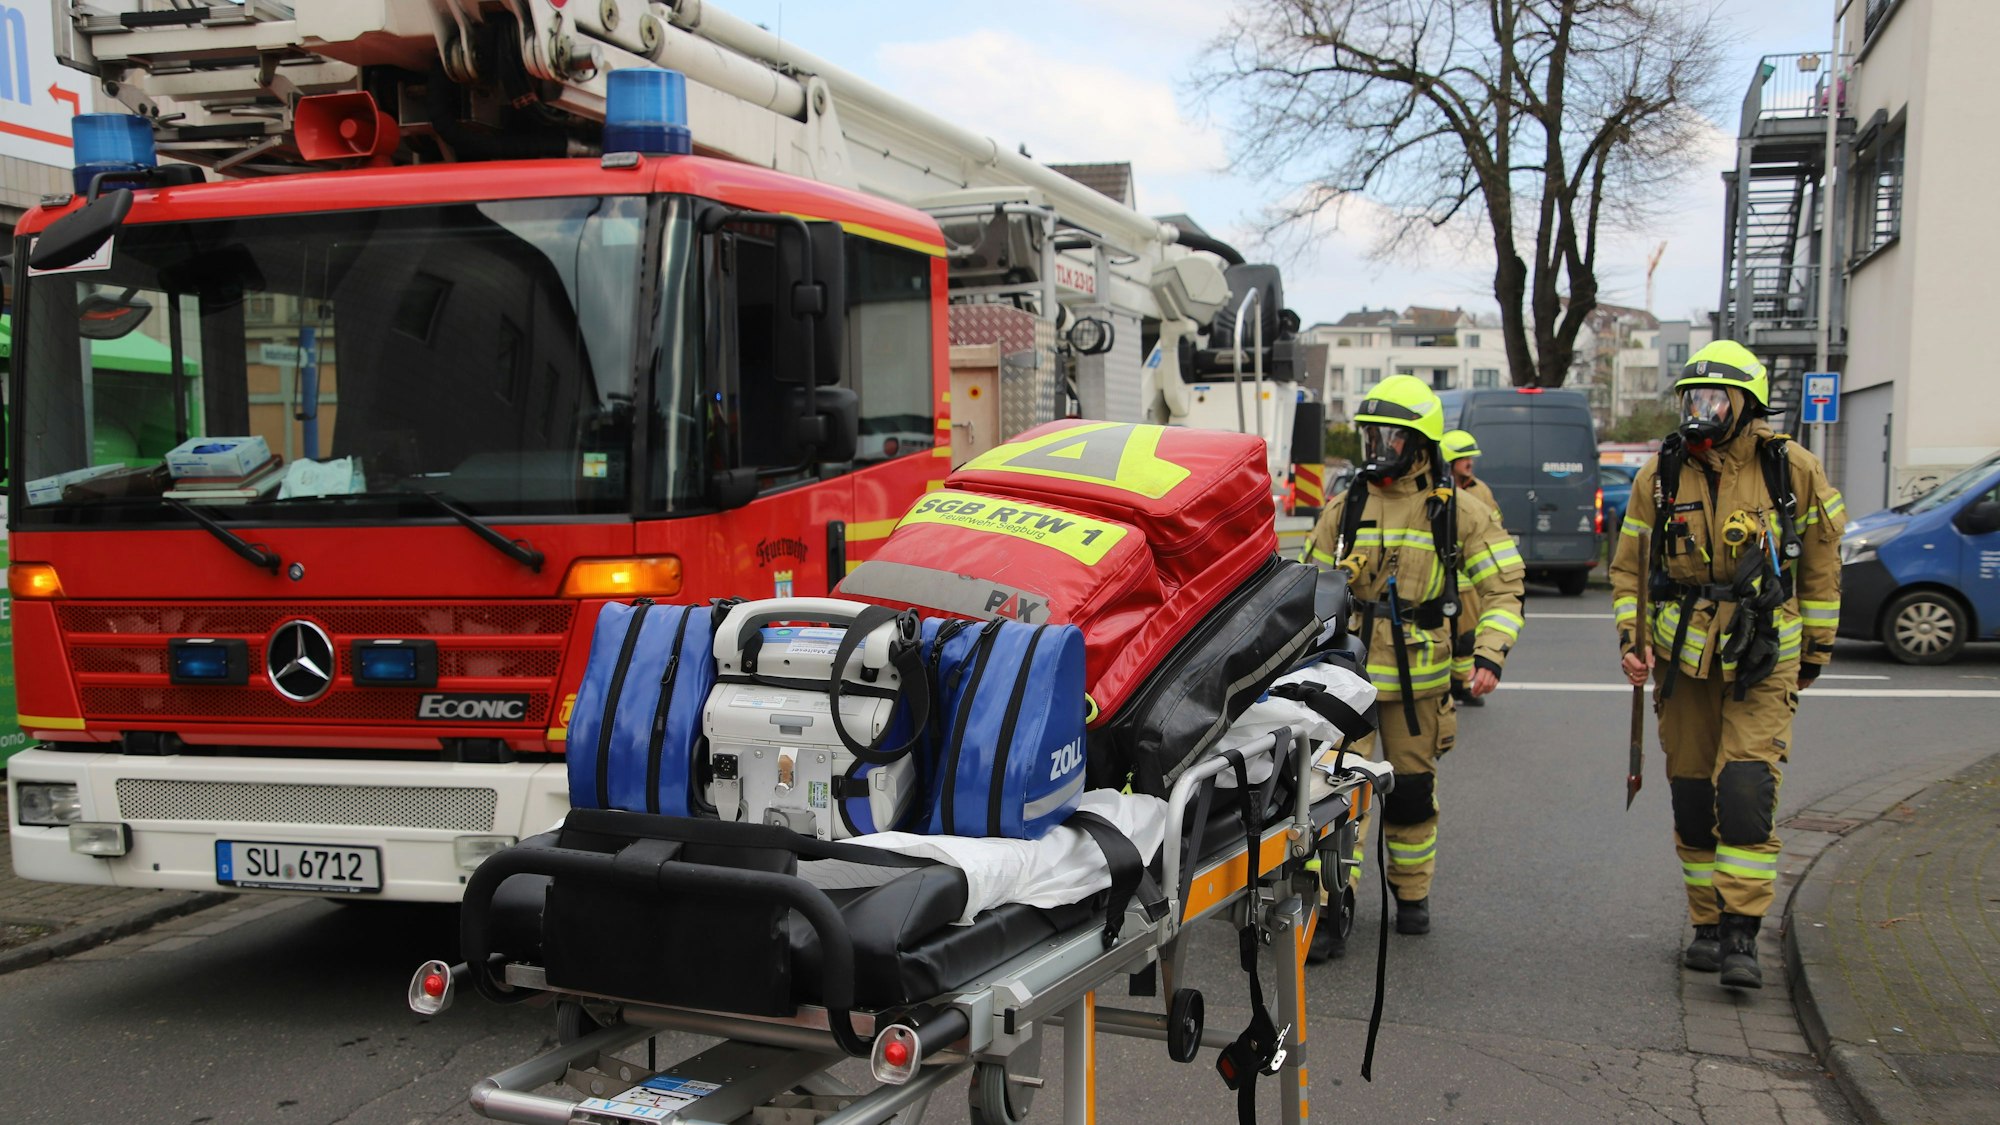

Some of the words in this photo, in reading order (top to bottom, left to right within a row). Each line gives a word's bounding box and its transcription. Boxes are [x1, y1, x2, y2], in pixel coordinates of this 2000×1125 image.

[1056, 264, 1073, 285] TLK
[1542, 462, 1583, 472] amazon
[916, 498, 986, 516] SGB
[987, 507, 1076, 534] RTW
[1080, 529, 1104, 546] 1
[939, 513, 998, 529] Feuerwehr
[996, 521, 1047, 540] Siegburg
[756, 536, 808, 567] Feuerwehr
[984, 589, 1041, 623] PAX
[1050, 736, 1083, 781] ZOLL
[246, 848, 280, 877] SU
[300, 850, 363, 881] 6712
[631, 1106, 652, 1116] H
